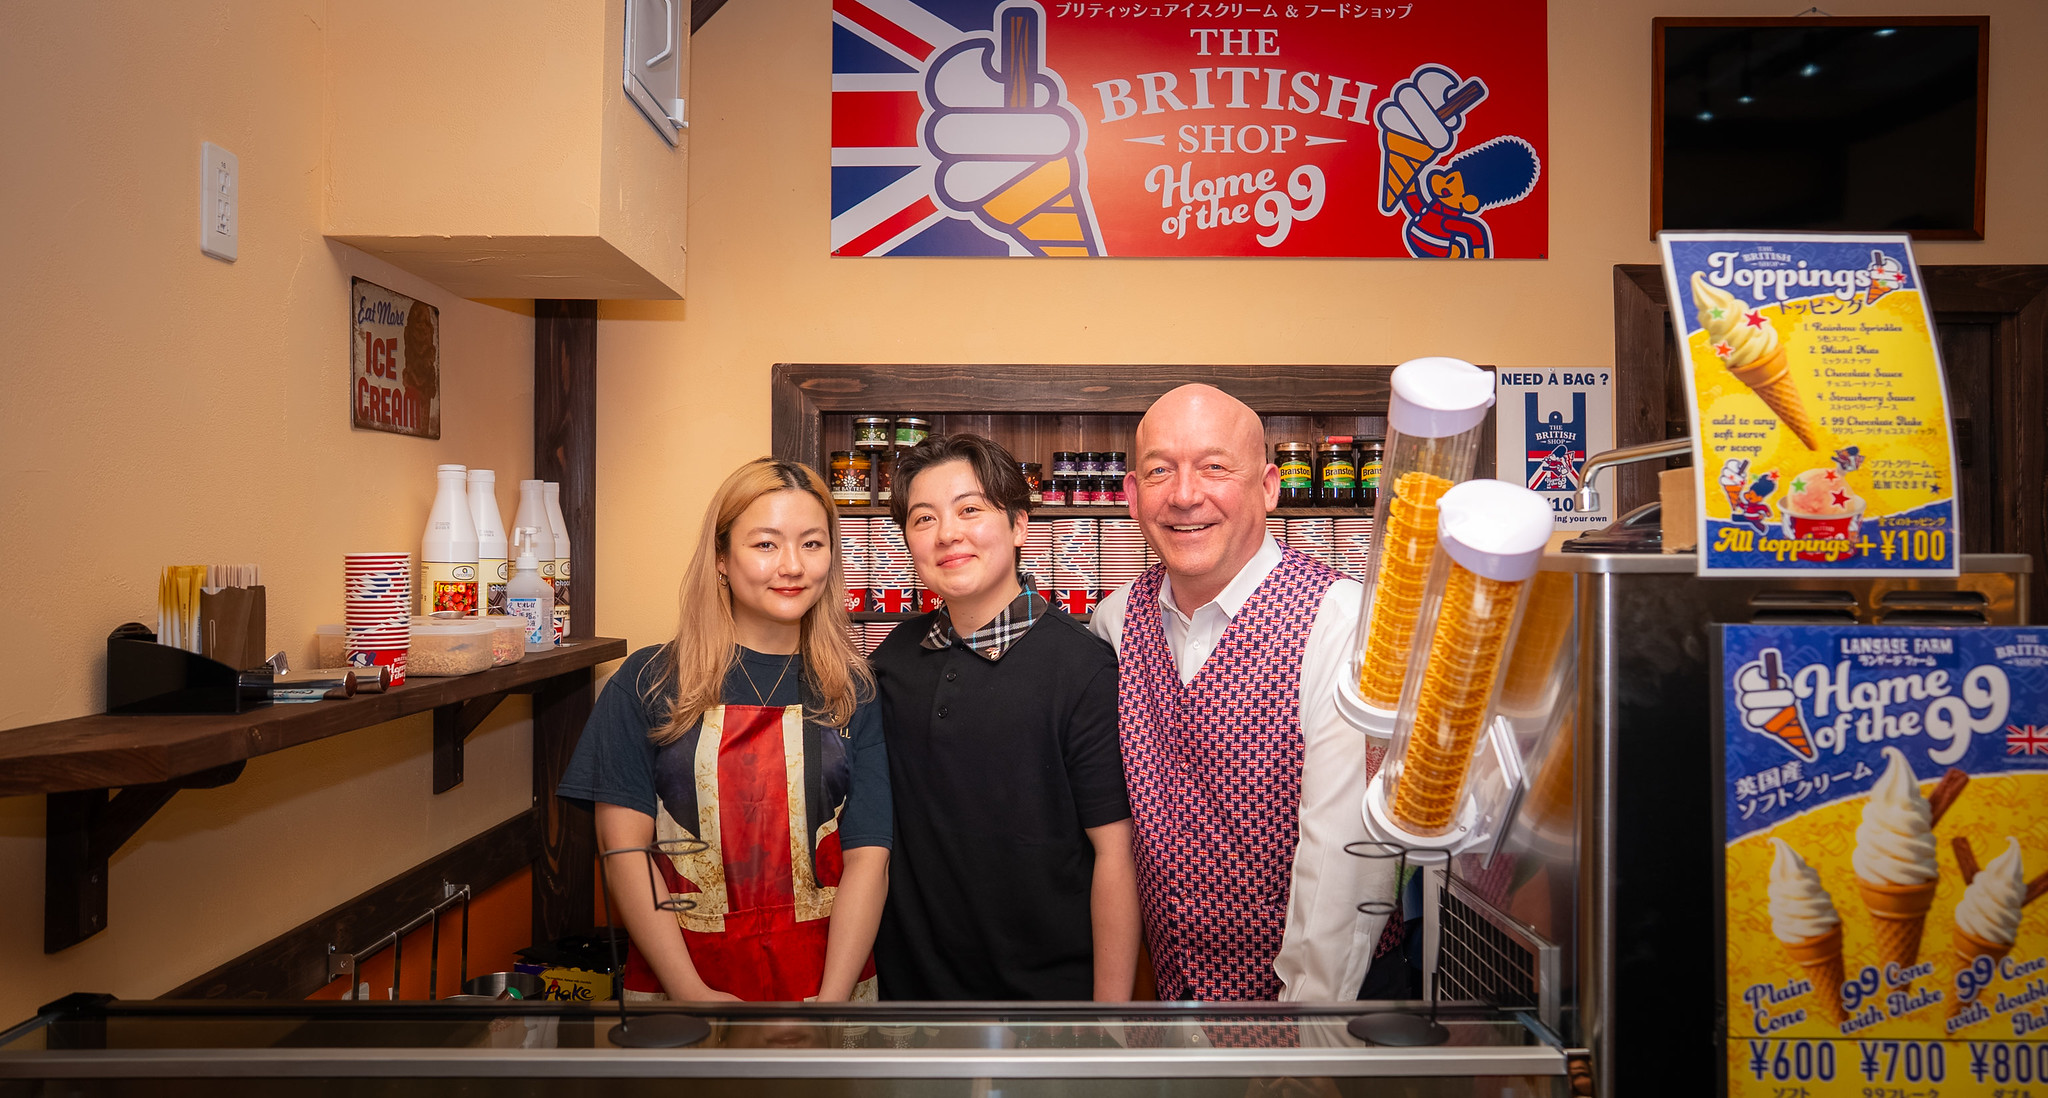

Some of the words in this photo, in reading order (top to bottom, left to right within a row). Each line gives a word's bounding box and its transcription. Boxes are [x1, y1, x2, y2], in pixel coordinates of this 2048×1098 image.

[1056, 2, 1279, 19] ブリティッシュアイスクリーム
[1285, 4, 1299, 18] &
[1306, 2, 1414, 20] フードショップ
[1190, 29, 1280, 56] THE
[1092, 67, 1378, 125] BRITISH
[1178, 124, 1297, 153] SHOP
[1144, 162, 1277, 208] Home
[1162, 205, 1192, 239] of
[1196, 196, 1251, 230] the
[1254, 165, 1326, 247] 99
[1742, 252, 1791, 262] BRITISH
[1707, 251, 1873, 301] Toppings
[358, 296, 375, 325] Eat
[377, 301, 404, 326] More
[1778, 299, 1863, 315] トッピング
[1859, 322, 1902, 335] Sprinkles
[366, 331, 397, 380] ICE
[1821, 345, 1853, 354] Mixed
[1856, 345, 1879, 354] Nuts
[1501, 373, 1543, 385] NEED
[1548, 373, 1558, 385] A
[1563, 373, 1595, 385] BAG
[1600, 373, 1609, 385] ?
[1825, 368, 1870, 377] Chocolate
[1874, 368, 1903, 377] Sauce
[358, 377, 421, 429] CREAM
[1829, 392, 1884, 405] Strawberry
[1886, 392, 1916, 402] Sauce
[1712, 414, 1735, 425] add
[1753, 419, 1776, 430] any
[1831, 417, 1844, 426] 99
[1847, 416, 1893, 426] Chocolate
[1896, 416, 1922, 426] Flake
[1535, 431, 1577, 441] BRITISH
[1714, 429, 1734, 440] soft
[1730, 445, 1762, 457] scoop
[1280, 468, 1310, 477] Branston
[1363, 468, 1383, 477] Brans
[1872, 470, 1942, 479] アイスクリームに
[1873, 480, 1927, 490] 追加できます
[1547, 498, 1573, 512] 10
[1553, 515, 1567, 523] ing
[1713, 527, 1754, 553] All
[1758, 530, 1850, 561] toppings
[436, 582, 466, 593] fresa
[491, 584, 506, 592] choc
[1840, 637, 1909, 654] LANGAGE
[1914, 637, 1953, 654] FARM
[2016, 634, 2039, 642] THE
[1995, 644, 2048, 660] BRITIS
[1794, 660, 1952, 718] Home
[1815, 713, 1853, 755] of
[1855, 703, 1922, 744] the
[1924, 664, 2011, 765] 99
[1735, 760, 1803, 802] 英国産
[1737, 761, 1873, 821] ソフトクリーム
[1841, 966, 1880, 1011] 99
[1884, 961, 1934, 988] Cone
[1956, 954, 1995, 1001] 99
[1998, 955, 2048, 981] Cone
[1743, 977, 1813, 1011] Plain
[1840, 1004, 1885, 1036] with
[1886, 988, 1944, 1017] Flake
[1946, 1000, 1990, 1033] with
[1752, 1008, 1808, 1036] Cone
[1749, 1040, 1836, 1083] ¥600
[1860, 1040, 1946, 1083] ¥700
